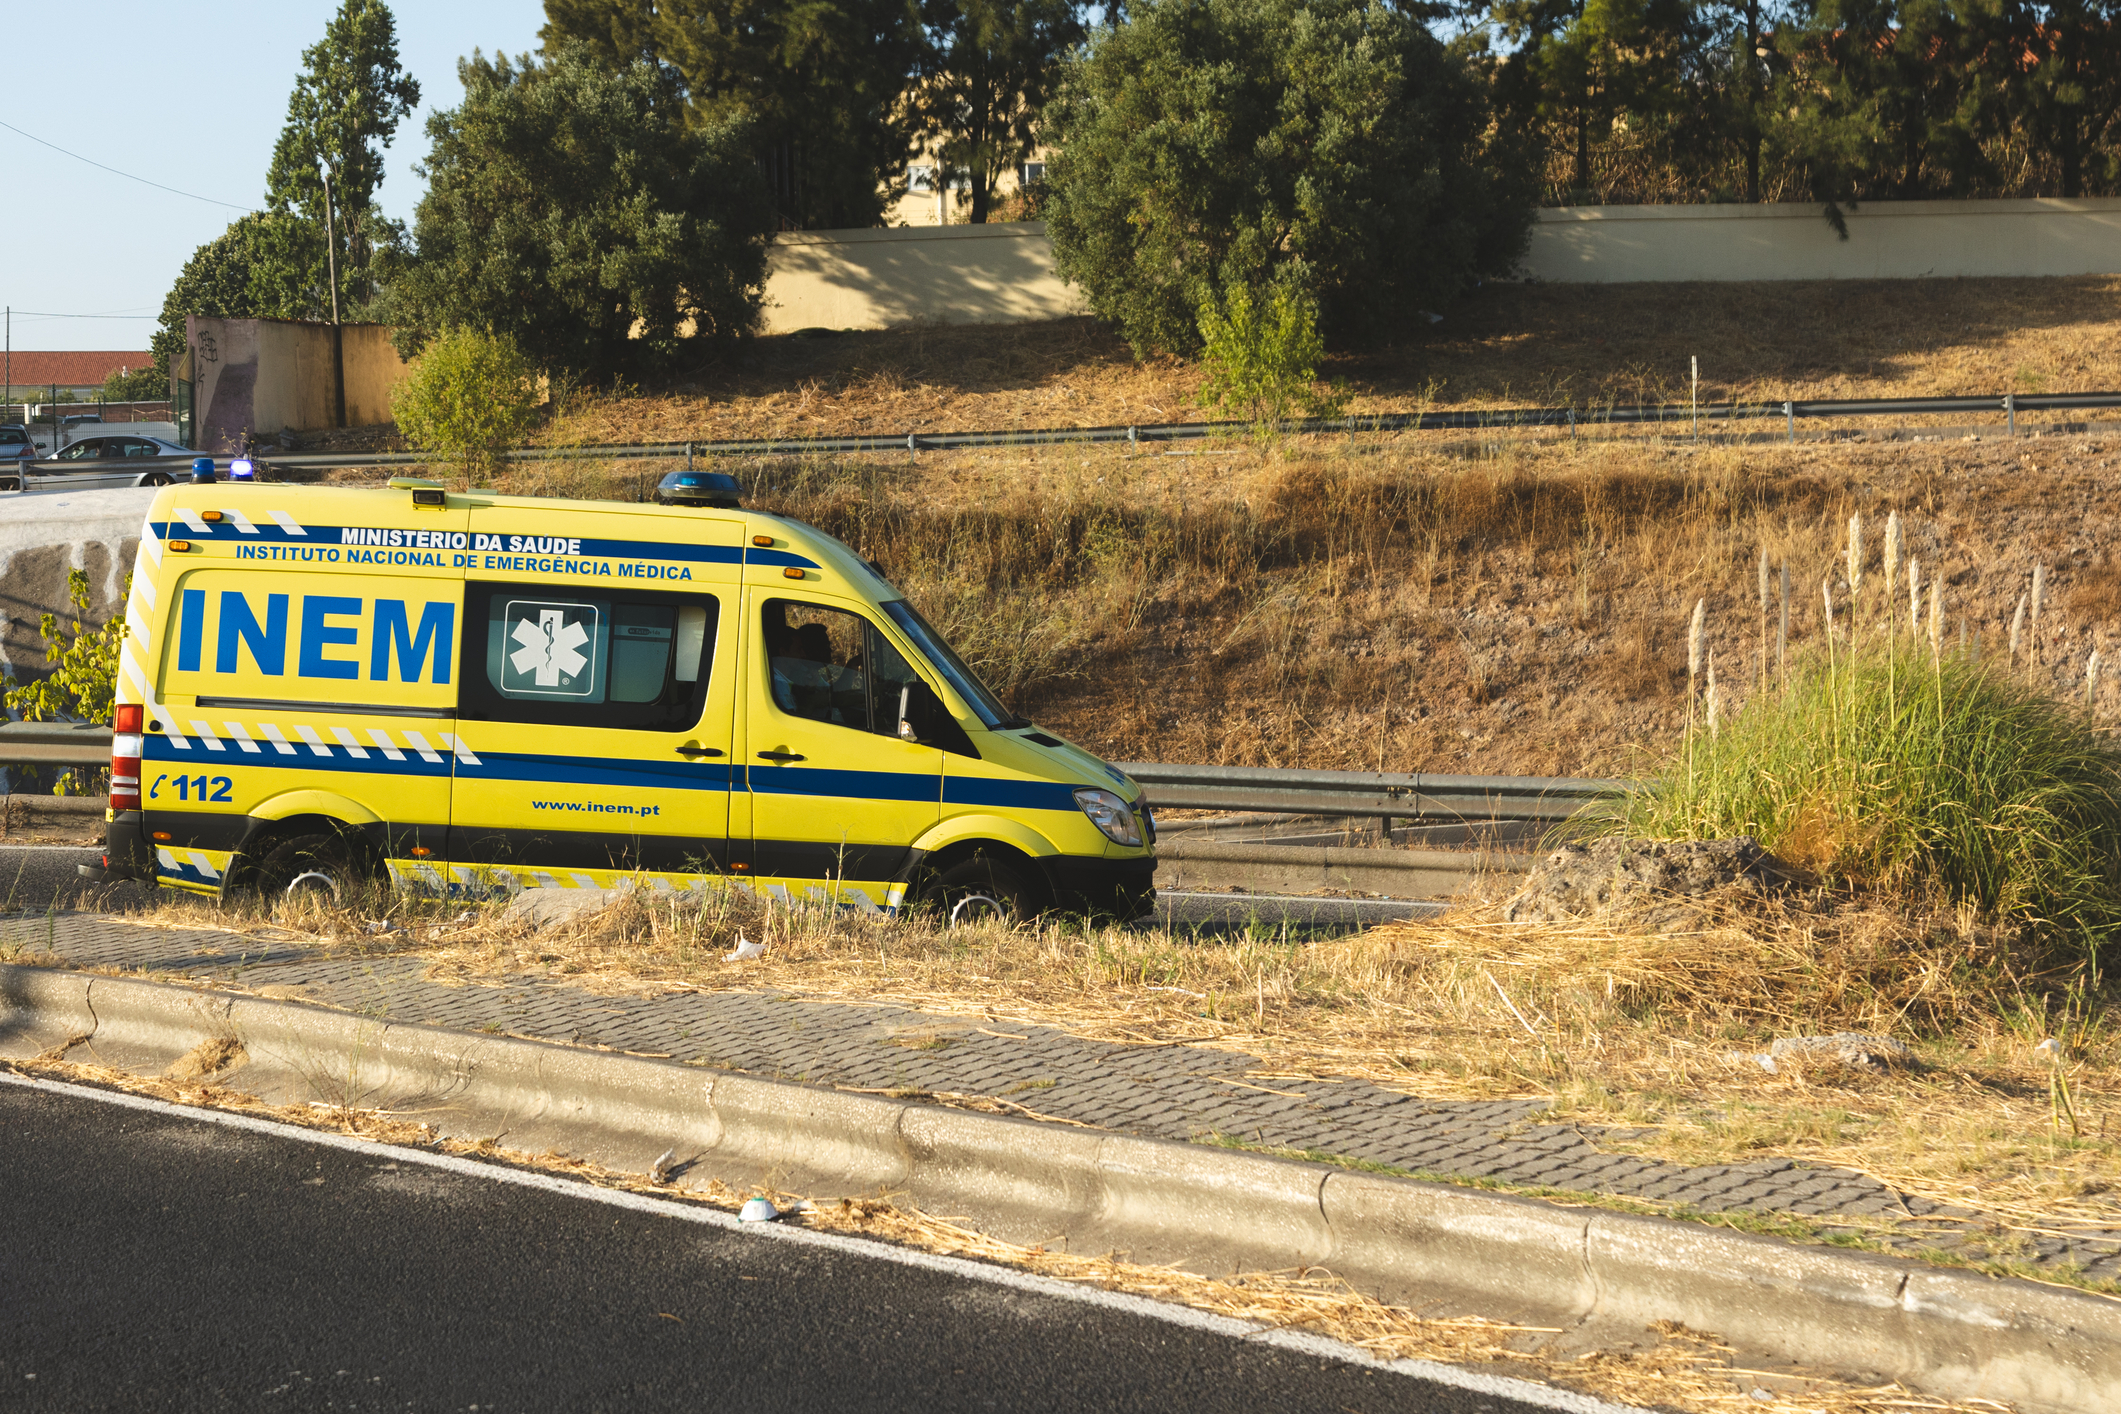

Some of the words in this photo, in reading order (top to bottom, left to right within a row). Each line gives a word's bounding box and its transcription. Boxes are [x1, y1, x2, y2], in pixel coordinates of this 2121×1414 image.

[341, 527, 467, 550] MINISTÉRIO
[475, 533, 503, 551] DA
[509, 533, 581, 555] SAÚDE
[236, 545, 340, 562] INSTITUTO
[347, 549, 446, 567] NACIONAL
[453, 554, 478, 568] DE
[484, 555, 611, 576] EMERGÊNCIA
[618, 561, 692, 580] MÉDICA
[178, 589, 455, 684] INEM
[172, 774, 233, 803] 112
[532, 800, 660, 817] www.inem.pt
